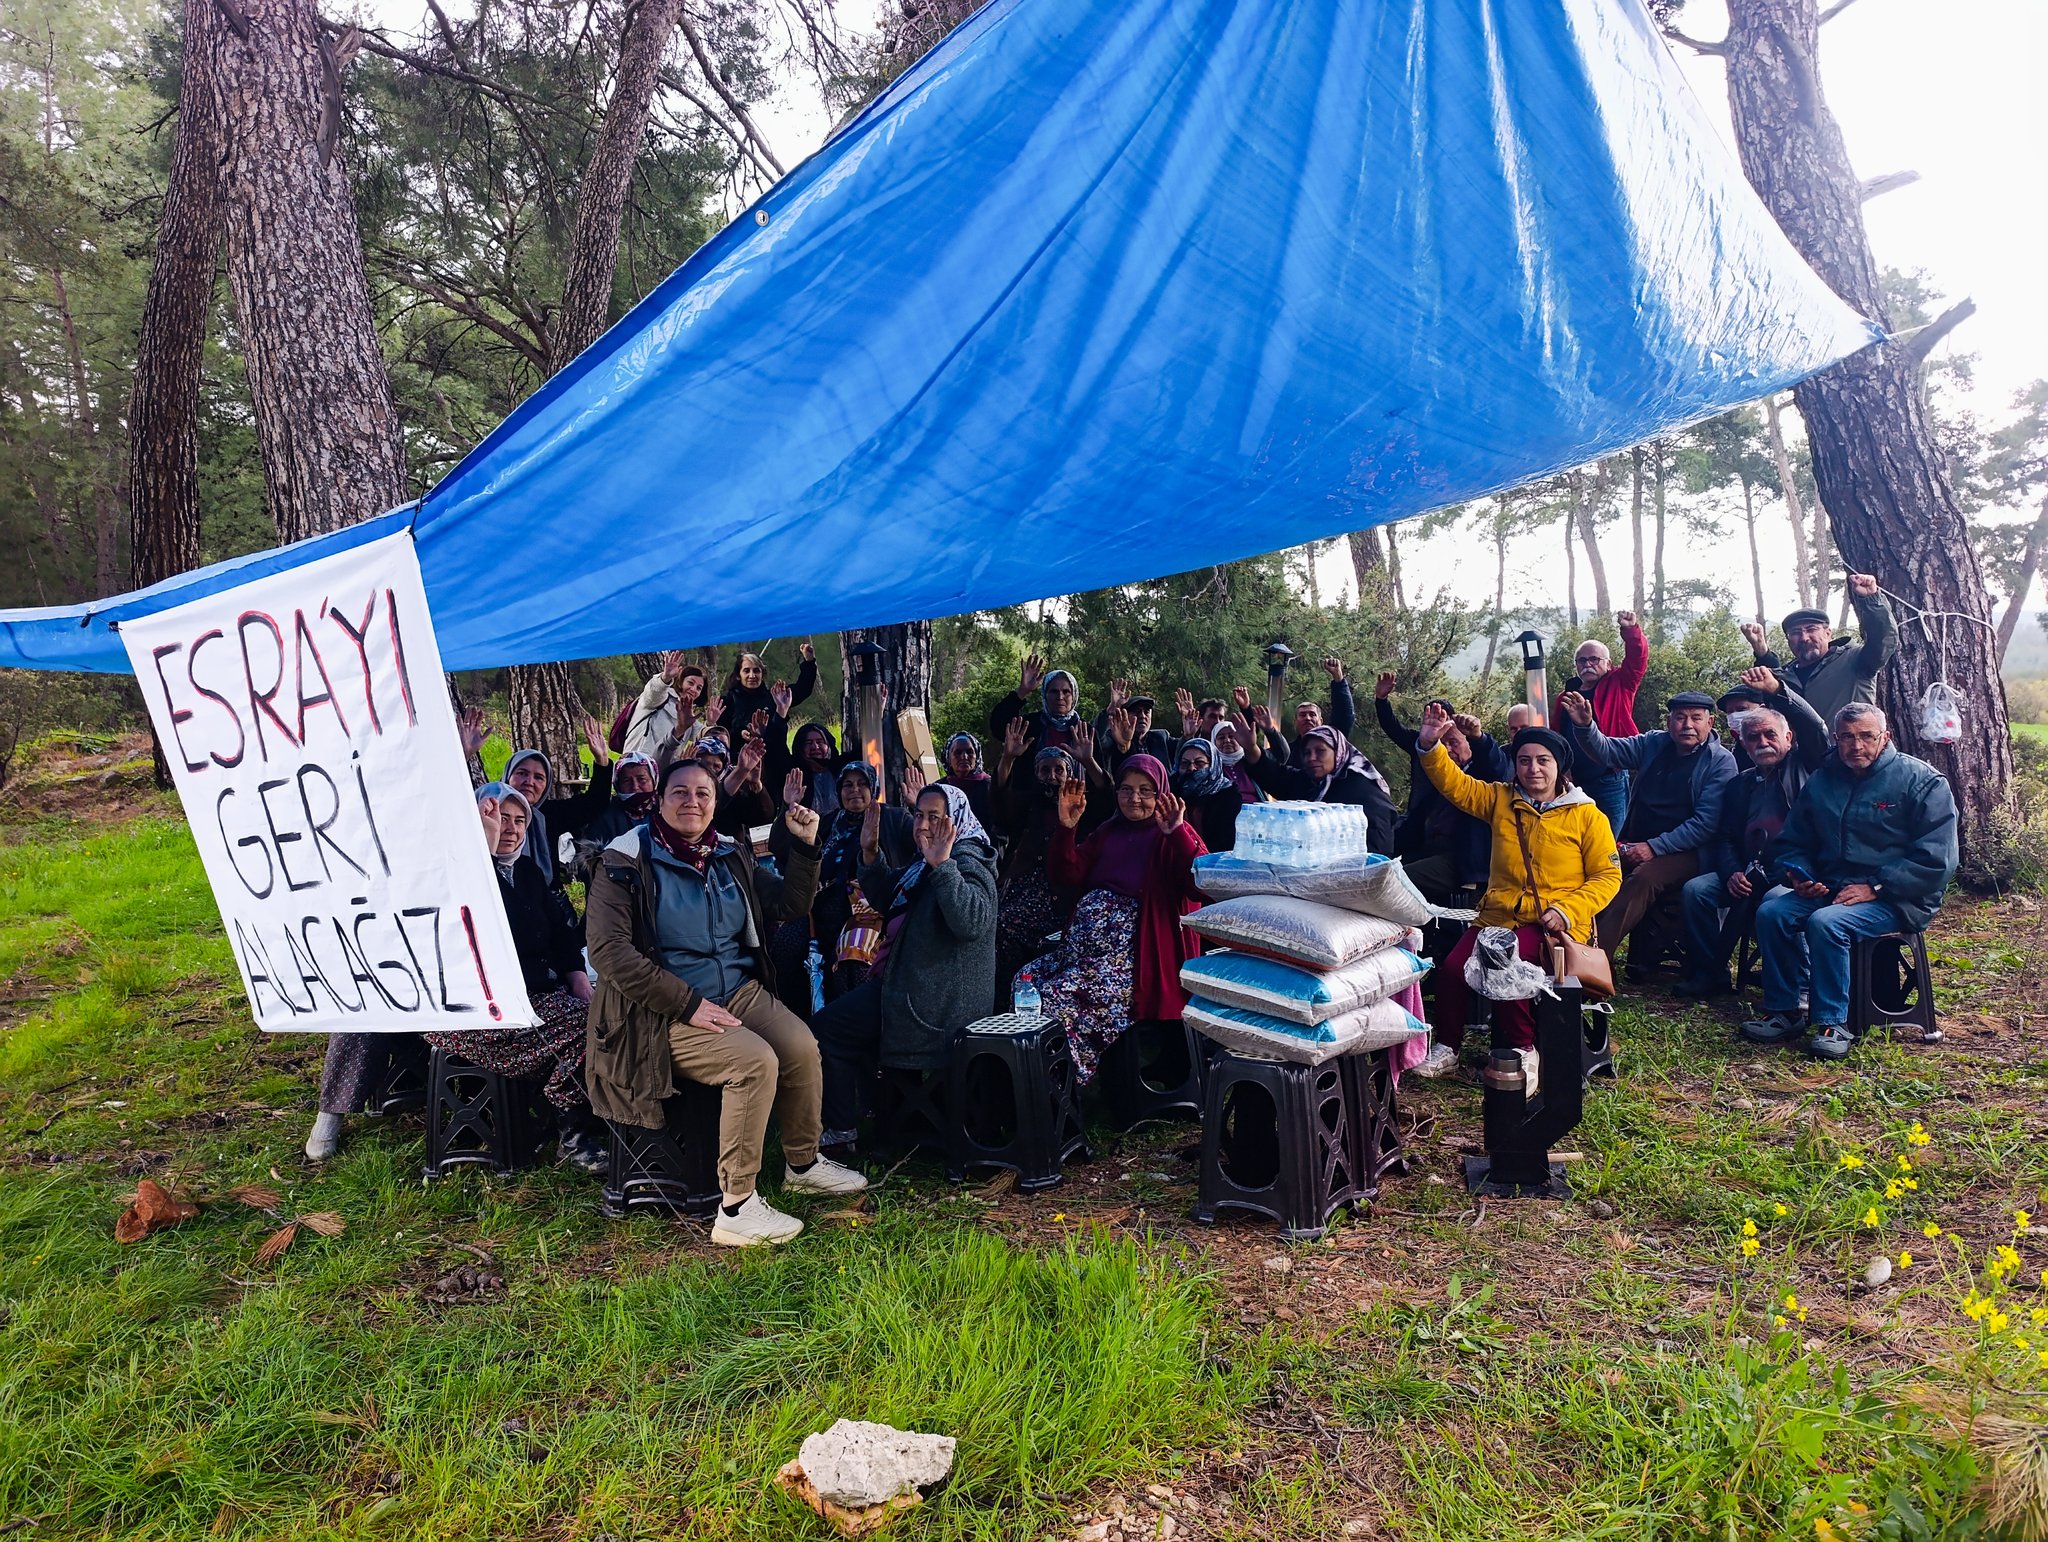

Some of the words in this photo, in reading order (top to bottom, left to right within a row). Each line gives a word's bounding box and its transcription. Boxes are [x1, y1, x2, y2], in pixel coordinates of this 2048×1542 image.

[153, 588, 417, 773] ESRA'YI
[217, 750, 391, 900] GERİ
[235, 896, 502, 1021] ALACAĞIZ!
